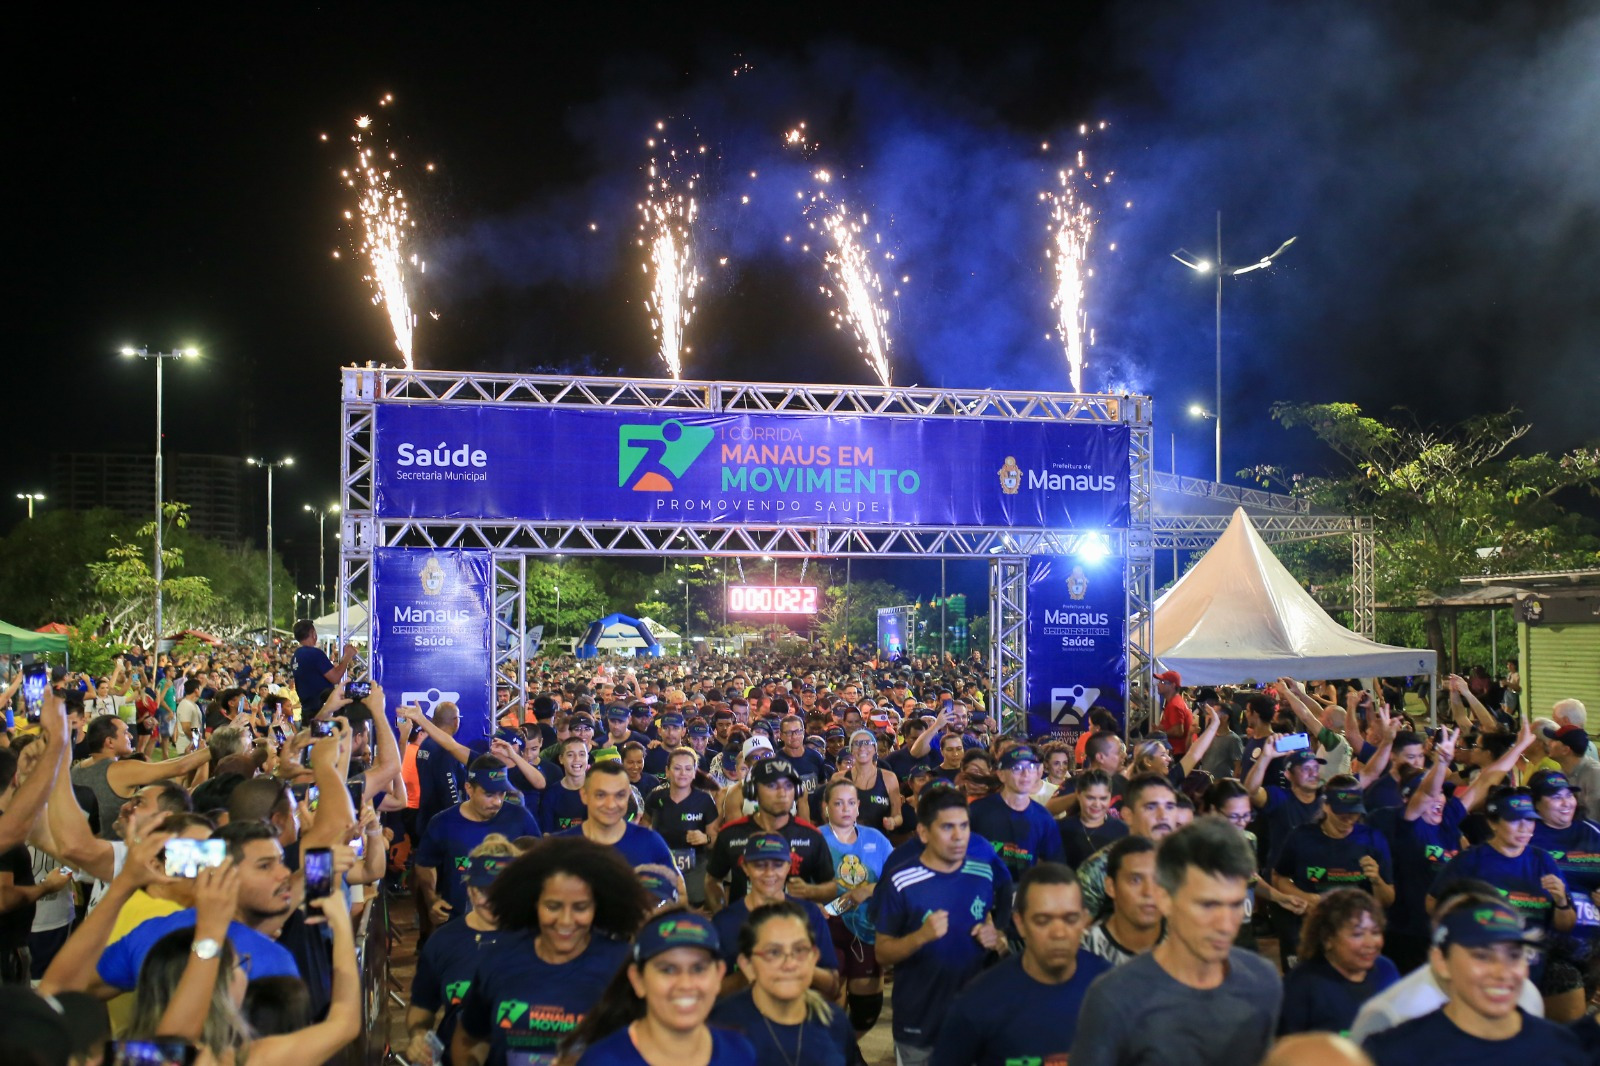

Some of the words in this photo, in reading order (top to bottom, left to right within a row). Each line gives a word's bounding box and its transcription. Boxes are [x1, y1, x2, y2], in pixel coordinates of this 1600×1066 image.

[729, 426, 803, 442] CORRIDA
[397, 441, 487, 468] Saúde
[721, 444, 831, 466] MANAUS
[838, 446, 874, 467] EM
[1052, 462, 1082, 470] Prefeitura
[396, 470, 443, 481] Secretaria
[444, 471, 487, 482] Municipal
[721, 467, 921, 495] MOVIMENTO
[1028, 469, 1116, 492] Manaus
[656, 499, 801, 511] PROMOVENDO
[814, 498, 880, 513] SAÚDE
[394, 605, 470, 623] Manaus
[1044, 609, 1109, 625] Manaus
[414, 635, 454, 646] Saúde
[1062, 636, 1095, 646] Saúde
[529, 1020, 576, 1032] MOVIM
